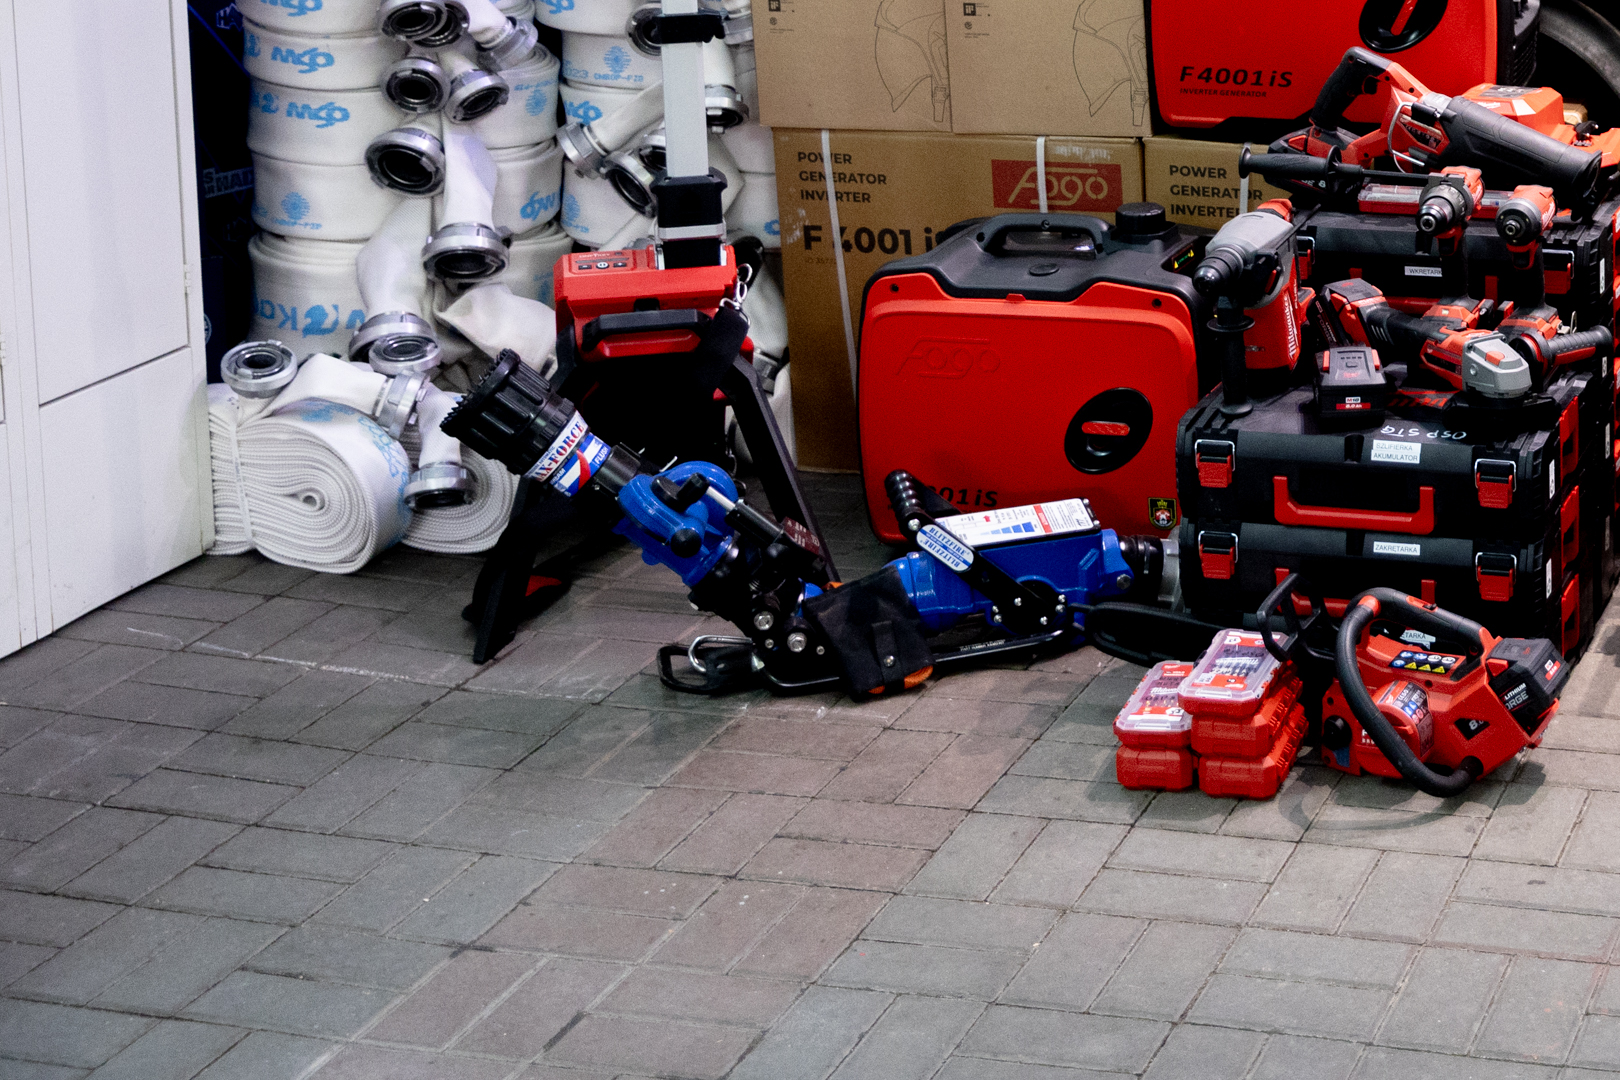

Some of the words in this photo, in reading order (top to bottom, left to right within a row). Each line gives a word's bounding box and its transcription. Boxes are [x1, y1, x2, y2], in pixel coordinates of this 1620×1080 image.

[1180, 66, 1196, 82] F
[1197, 66, 1263, 87] 4001
[1268, 68, 1293, 88] iS
[1179, 87, 1217, 96] INVERTER
[1218, 89, 1267, 98] GENERATOR
[1169, 164, 1227, 179] POWER
[800, 189, 871, 203] INVRTER
[803, 225, 823, 250] F
[1283, 294, 1297, 360] Milwaukee
[1426, 430, 1467, 439] OSP
[534, 421, 585, 481] AX-FORCE
[594, 446, 609, 464] FLUSH
[1376, 442, 1413, 451] SZLIFIERKA
[1373, 452, 1418, 461] AKUMULATOR
[974, 488, 998, 507] iS
[929, 527, 966, 556] BLITZFIRE
[924, 538, 961, 568] BLITZFIRE
[1504, 682, 1526, 701] LITHIUM
